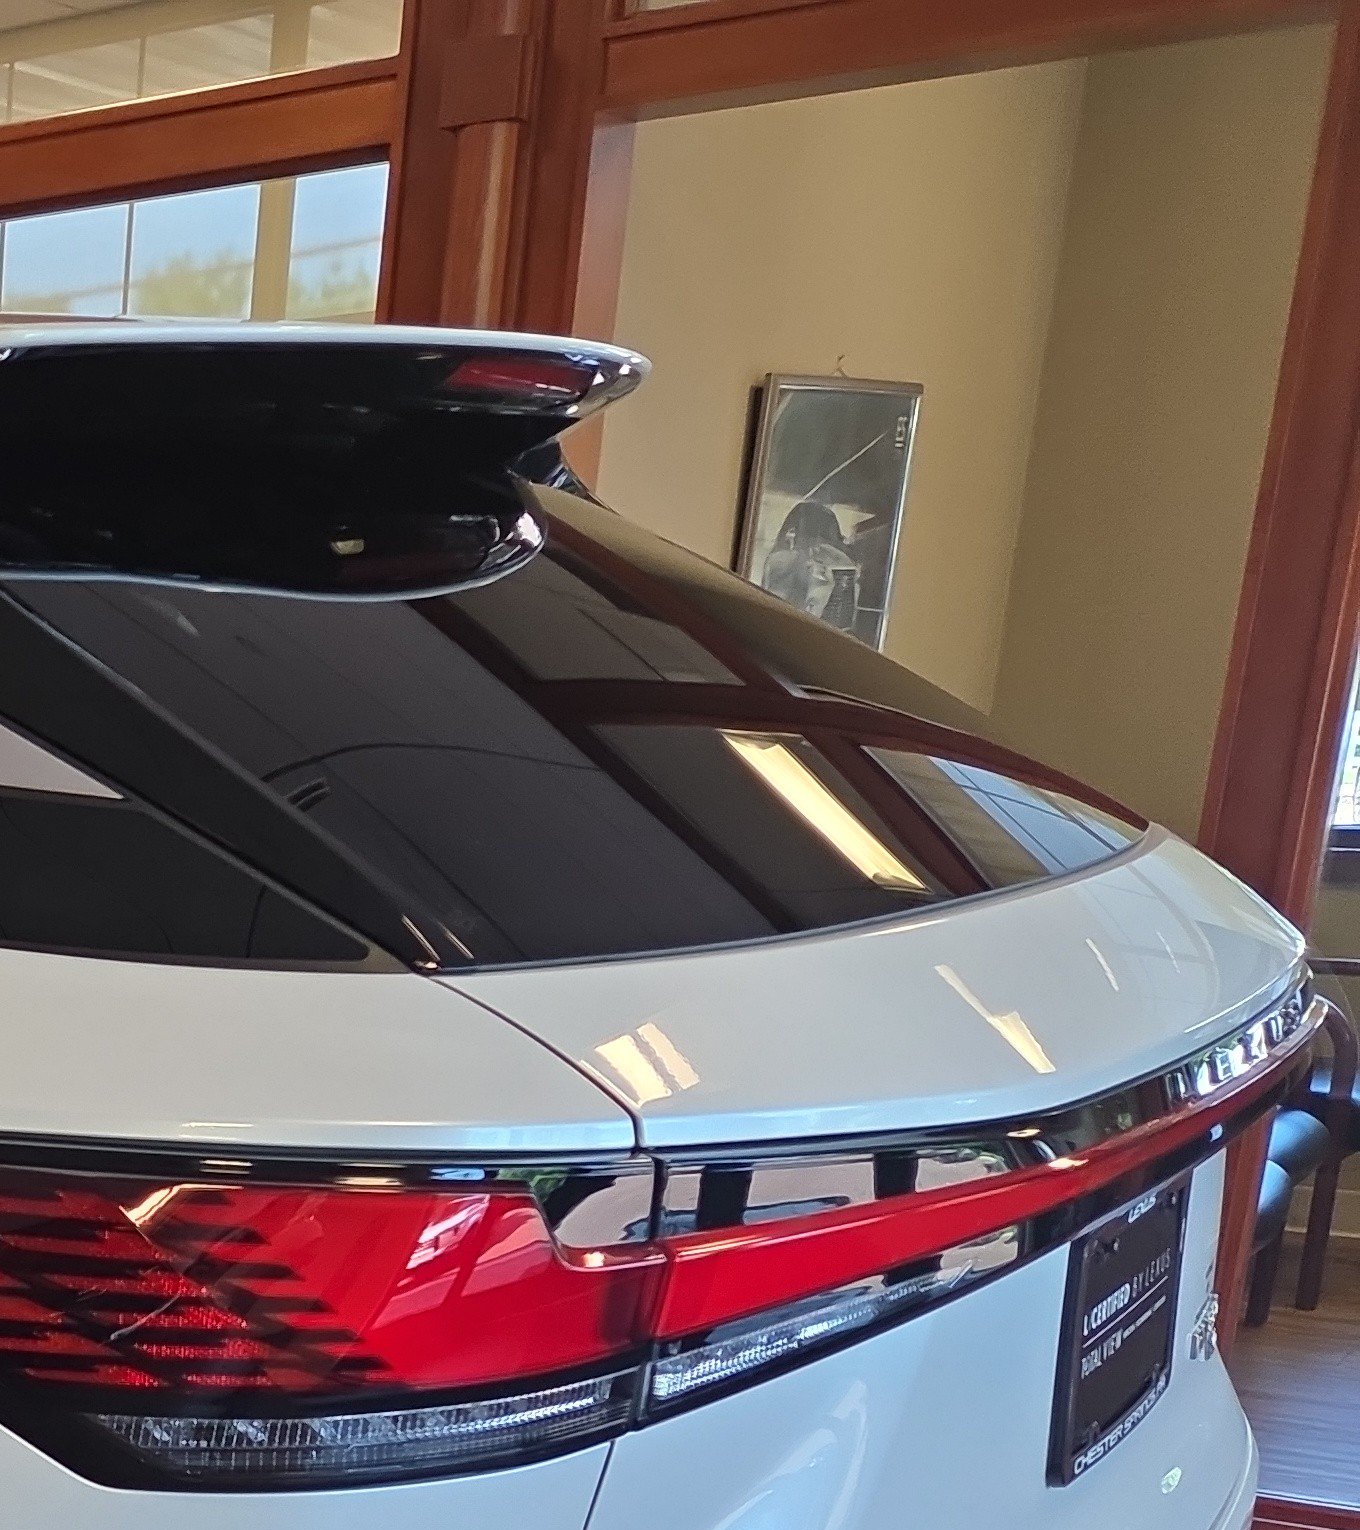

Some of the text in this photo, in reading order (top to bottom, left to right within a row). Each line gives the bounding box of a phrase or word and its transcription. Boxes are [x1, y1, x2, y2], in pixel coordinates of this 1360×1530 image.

[1128, 1196, 1157, 1223] LEXUS
[1145, 1247, 1171, 1287] LEXUS
[1074, 1424, 1124, 1475] CHESTER
